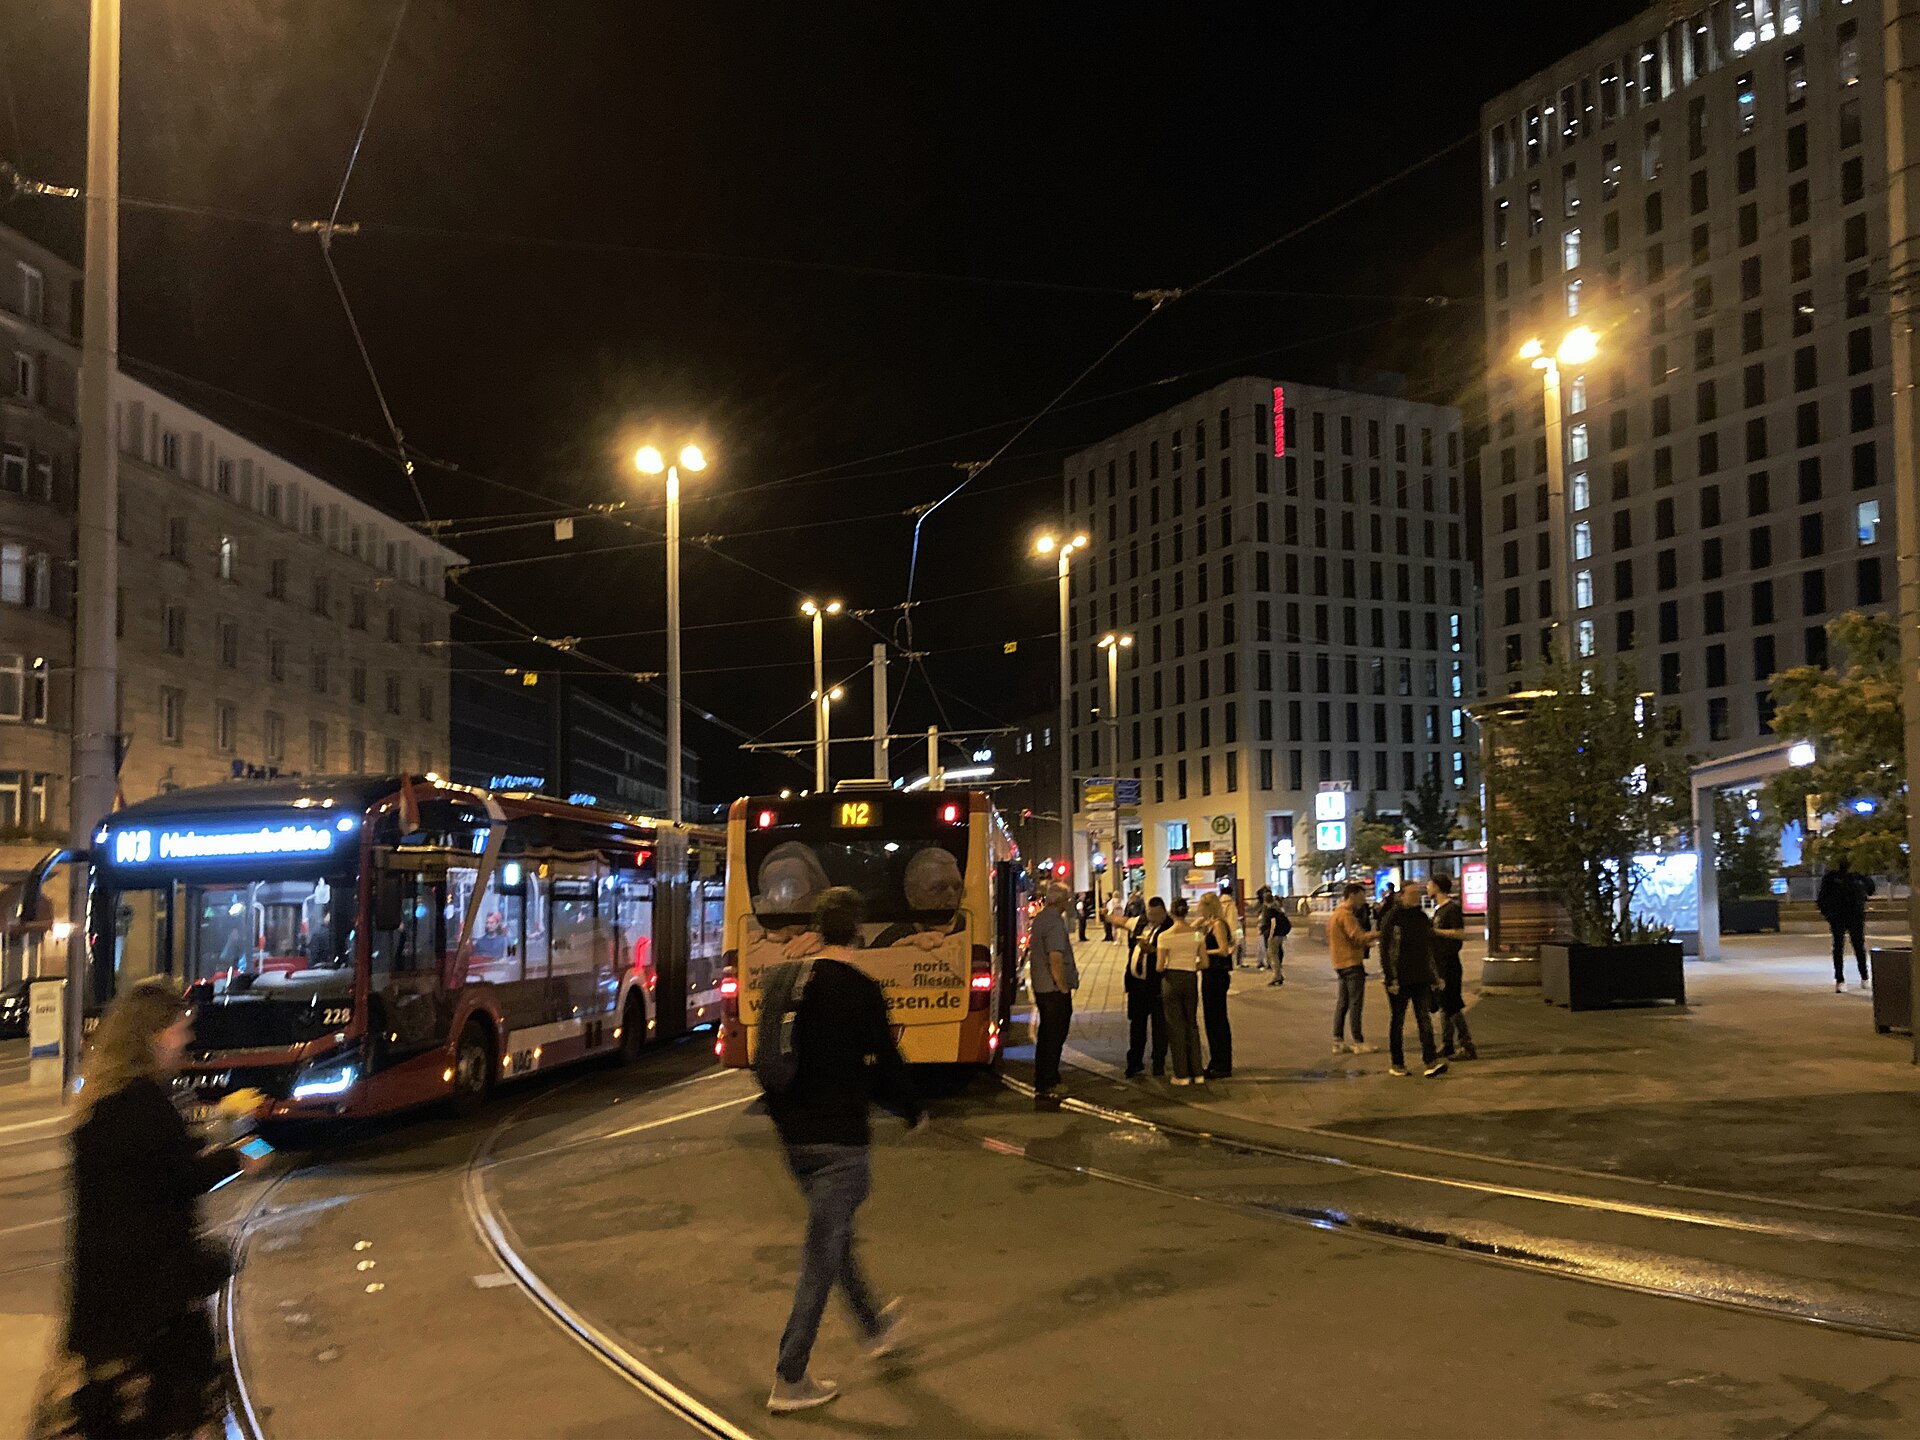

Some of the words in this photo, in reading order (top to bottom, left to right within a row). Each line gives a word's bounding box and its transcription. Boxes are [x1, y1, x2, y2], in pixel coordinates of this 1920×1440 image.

[841, 802, 869, 826] N2
[913, 959, 950, 972] noris
[323, 1008, 351, 1024] 228
